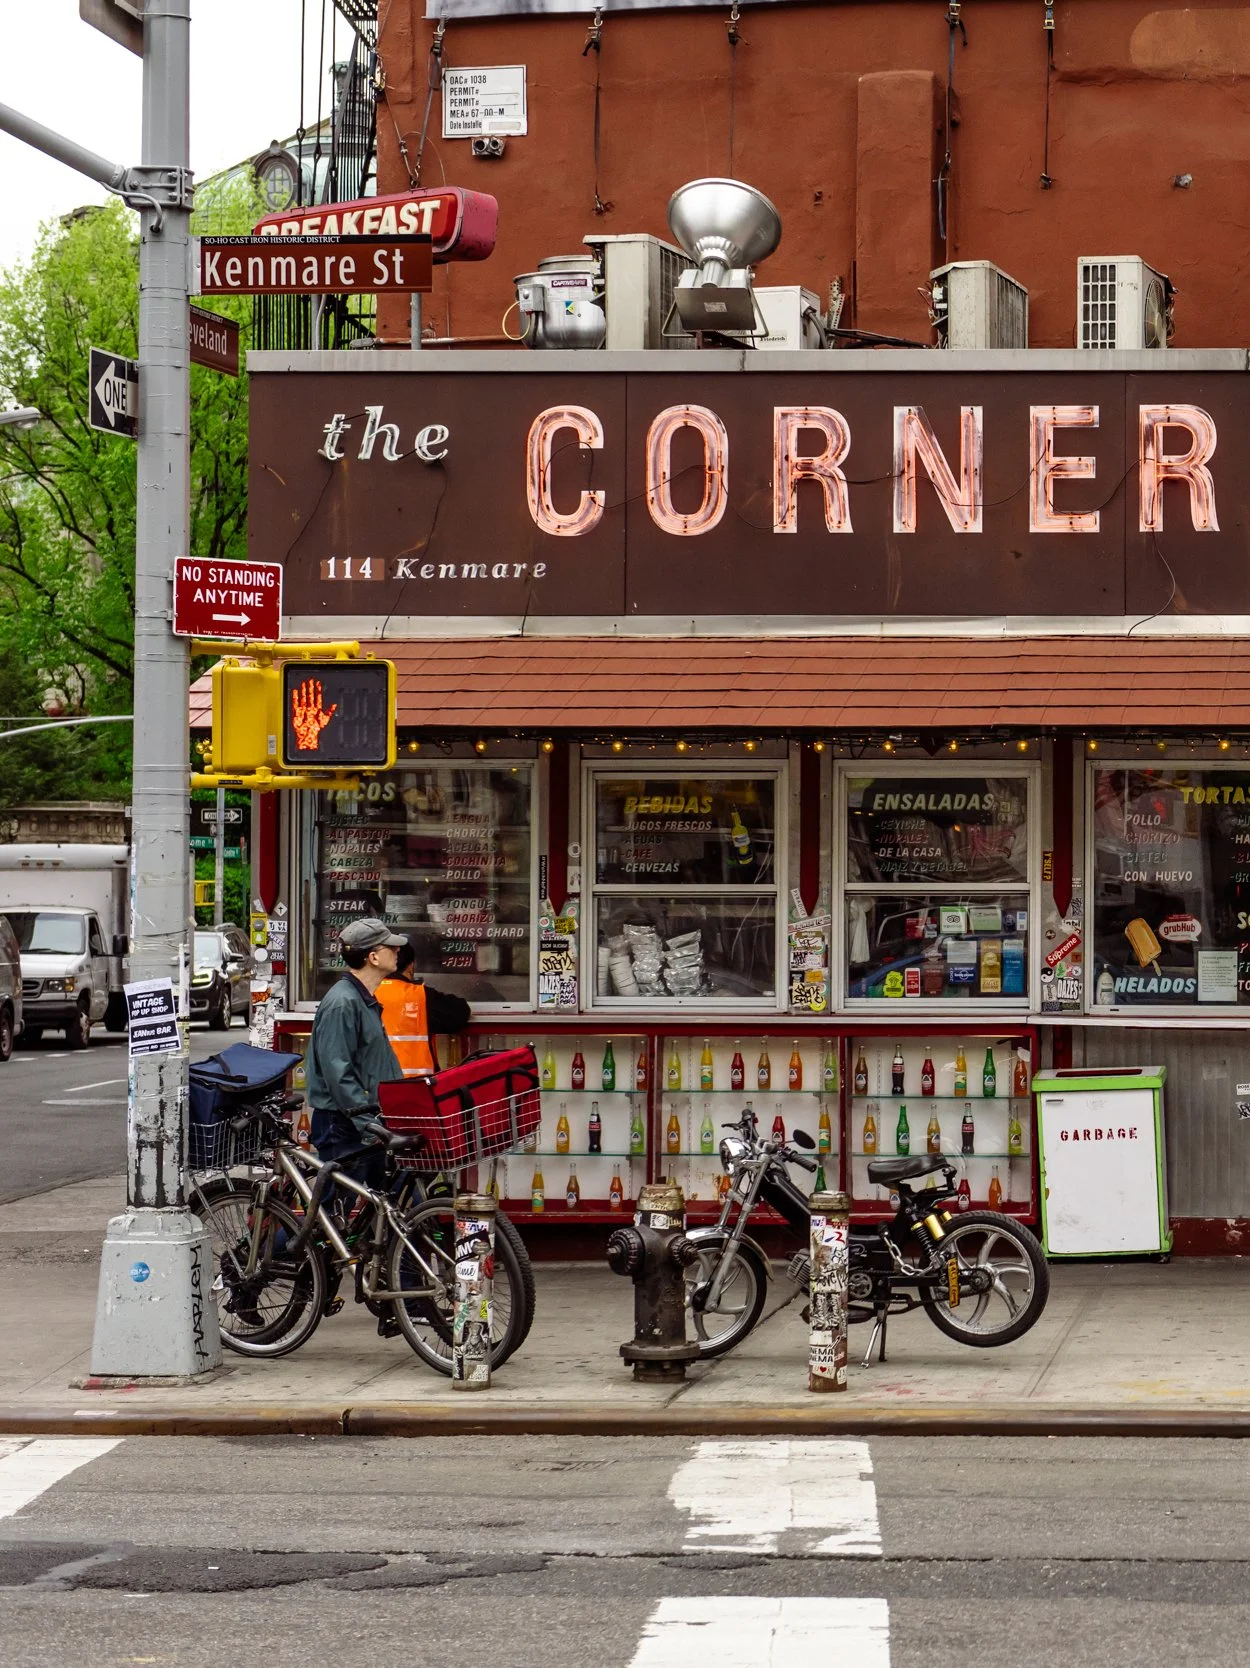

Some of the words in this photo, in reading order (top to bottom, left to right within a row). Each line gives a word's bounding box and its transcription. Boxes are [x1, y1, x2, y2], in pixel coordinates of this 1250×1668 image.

[450, 76, 468, 85] OAC#
[471, 75, 487, 84] 1038
[450, 87, 479, 96] PERMIT#
[450, 98, 479, 107] PERMIT#
[450, 109, 470, 118] MEA#
[450, 121, 461, 129] Date
[463, 120, 482, 129] Installe
[270, 236, 305, 244] HISTORIC
[205, 251, 356, 286] Kenmare
[373, 248, 404, 285] St
[190, 320, 227, 356] eveland
[104, 378, 127, 411] ONE
[317, 406, 449, 462] the
[526, 404, 1220, 536] CORNER
[327, 557, 373, 579] 114
[393, 557, 547, 580] Kenmare
[183, 566, 201, 582] NO
[208, 568, 275, 588] STANDING
[193, 588, 264, 607] ANYTIME
[624, 796, 713, 814] BEBIDAS
[873, 793, 995, 811] ENSALADAS
[664, 821, 713, 831] FRESCOS
[896, 848, 909, 858] LA
[913, 848, 942, 858] CASA
[1155, 871, 1193, 882] HUEVO
[486, 928, 524, 938] CHARD
[1048, 937, 1078, 965] Supreme
[540, 975, 560, 994] DAZES
[1057, 978, 1078, 1000] DAZES
[1115, 976, 1197, 994] HELADOS
[132, 997, 164, 1009] VINTAGE
[151, 1006, 168, 1014] SHOP
[156, 1026, 171, 1035] BAR
[1060, 1127, 1138, 1141] GARBAGE
